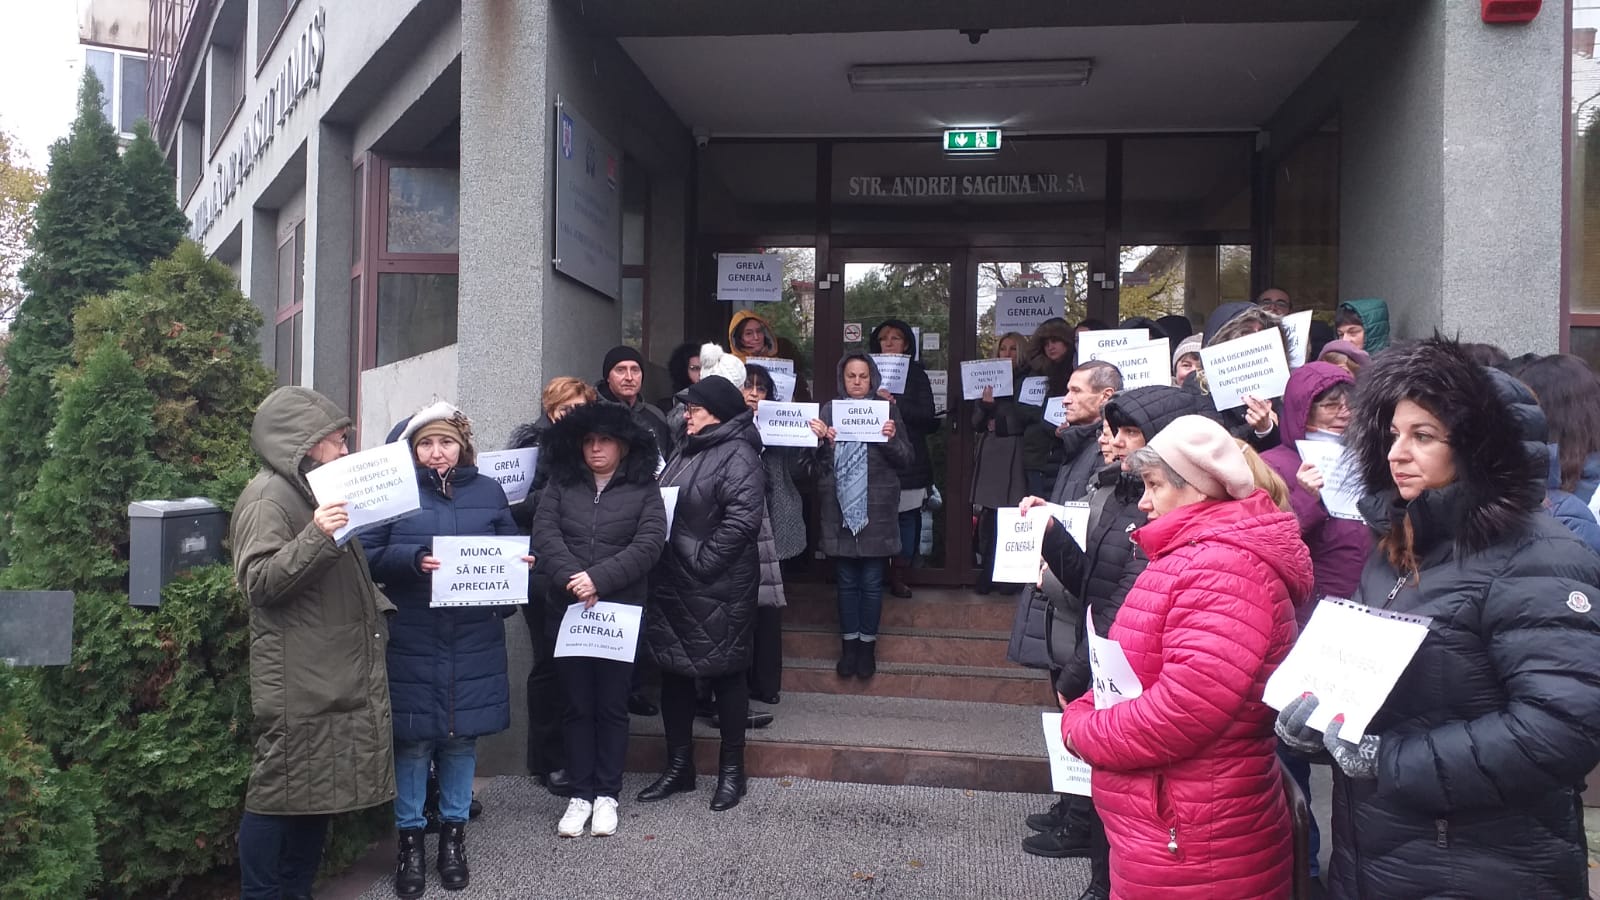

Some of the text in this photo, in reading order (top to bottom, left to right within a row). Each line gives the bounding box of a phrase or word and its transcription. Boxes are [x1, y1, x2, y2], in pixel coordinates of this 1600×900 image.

[849, 173, 1086, 197] STR. ANDREI SAGUNA NR. 5A
[736, 261, 764, 270] GREVĂ
[728, 273, 772, 282] GENERALĂ
[1015, 294, 1046, 304] GREVĂ
[1007, 307, 1054, 317] GENERALĂ
[1098, 337, 1128, 348] GREVĂ
[1118, 357, 1148, 368] MUNCA
[1226, 357, 1269, 374] SALARIZAREA
[1127, 373, 1137, 381] NE
[1140, 371, 1151, 379] FIE
[1236, 383, 1261, 395] PUBLICI
[775, 409, 802, 418] GREVĂ
[848, 406, 874, 415] GREVĂ
[768, 419, 809, 428] GENERALĂ
[841, 418, 881, 426] GENERALĂ
[494, 457, 520, 471] GREVĂ
[360, 470, 389, 484] RESPECT
[497, 471, 525, 485] NERALĂ
[364, 486, 376, 495] DE
[376, 476, 404, 491] MUNCĂ
[354, 494, 390, 510] ADECVATE
[460, 547, 502, 557] MUNCA
[456, 563, 505, 575] SĂ NE FIE
[450, 579, 510, 592] APRECIATĂ
[581, 610, 616, 623] GREVĂ
[569, 625, 624, 639] GENERALĂ
